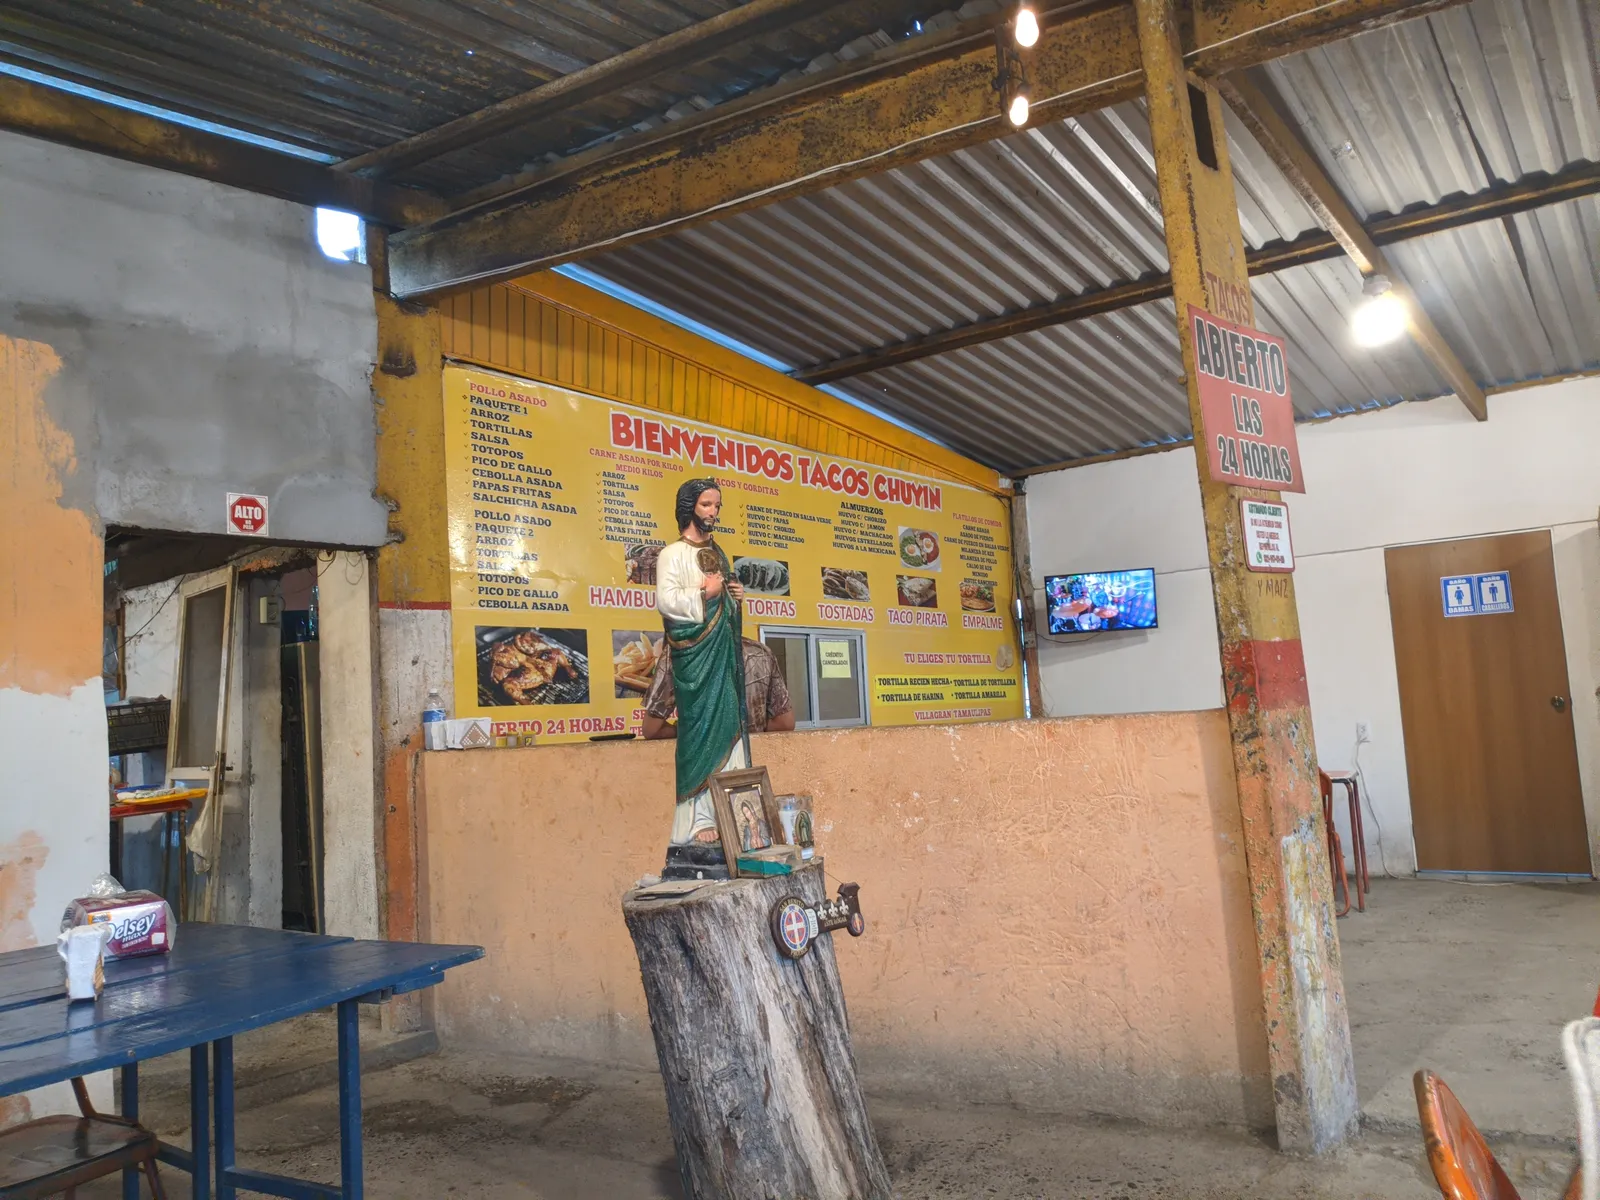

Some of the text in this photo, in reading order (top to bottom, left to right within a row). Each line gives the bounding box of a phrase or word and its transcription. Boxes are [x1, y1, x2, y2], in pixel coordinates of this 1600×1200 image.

[1205, 271, 1250, 325] TACOS
[1195, 316, 1286, 396] ABIERTO
[469, 382, 547, 408] POLLO ASADO
[469, 395, 528, 415] PAQUETE 1
[470, 407, 510, 423] ARROZ
[1231, 393, 1263, 437] LAS
[470, 419, 533, 439] TORTILLAS
[470, 431, 510, 447] SALSA
[471, 443, 524, 460] TOTOPOS
[589, 447, 617, 460] CARNE
[618, 452, 646, 465] ASADA
[647, 458, 661, 467] POR
[662, 461, 678, 471] KILO
[1217, 434, 1293, 484] 24 HORAS
[472, 455, 552, 477] PICO DE GALLO
[610, 412, 942, 511] BIENVENIDOS TACOS CHUYIN
[602, 471, 626, 481] ARROZ
[615, 463, 664, 479] MEDIO KILOS
[472, 468, 563, 490] CEBOLLA ASADA
[602, 479, 640, 491] TORTILLAS
[472, 480, 552, 499] PAPAS FRITAS
[603, 488, 626, 498] SALSA
[737, 481, 742, 489] Y
[743, 482, 779, 496] GORDITAS
[473, 492, 577, 515] SALCHICHA ASADA
[603, 497, 635, 508] TOTOPOS
[840, 501, 884, 516] ALMUERZOS
[234, 504, 263, 520] ALTO
[474, 509, 552, 527] POLLO ASADO
[604, 506, 620, 515] PICO
[630, 510, 651, 519] GALLO
[746, 504, 765, 513] CARNE
[773, 508, 793, 518] PUERCO
[838, 511, 857, 520] HUEVO
[864, 515, 887, 525] CHORIZO
[604, 516, 658, 529] CEBOLLA ASADA
[746, 513, 765, 521] HUEVO
[773, 516, 789, 525] PAPAS
[747, 521, 766, 530] HUEVO
[840, 519, 859, 528] HUEVO
[475, 522, 534, 537] PAQUETE 2
[605, 525, 651, 537] PAPAS FRITAS
[748, 530, 767, 538] HUEVO
[833, 525, 852, 534] HUEVO
[860, 530, 894, 540] MACHACADO
[476, 535, 515, 547] ARROZ
[605, 534, 667, 547] SALCHICHA ASADA
[749, 538, 767, 547] HUEVO
[834, 533, 894, 548] HUEVOS ESTRELLADOS
[832, 541, 855, 551] HUEVOS
[867, 546, 896, 556] MEXICANA
[478, 573, 529, 585] TOTOPOS
[478, 586, 559, 599] PICO DE GALLO
[1257, 578, 1289, 598] Y MAIZ
[478, 599, 569, 612] CEBOLLA ASADA
[746, 598, 796, 617] TORTAS
[817, 603, 874, 622] TOSTADAS
[1482, 603, 1509, 611] CABALLEROS
[887, 609, 948, 626] TACO PIRATA
[962, 615, 1003, 630] EMPALME
[904, 653, 992, 664] TU ELIGES TU TORTILLA
[877, 677, 950, 686] TORTILLA RECIEN HECHA
[953, 678, 1017, 687] TORTILLA DE TORTILLERA
[881, 692, 944, 703] TORTILLA DE HARINA
[954, 690, 1007, 700] TORTILLA AMARILLA
[914, 708, 992, 721] VILLAGRAN TAMAULIPAS
[490, 719, 543, 738] IERTO
[546, 718, 566, 736] 24
[568, 716, 626, 734] HORAS
